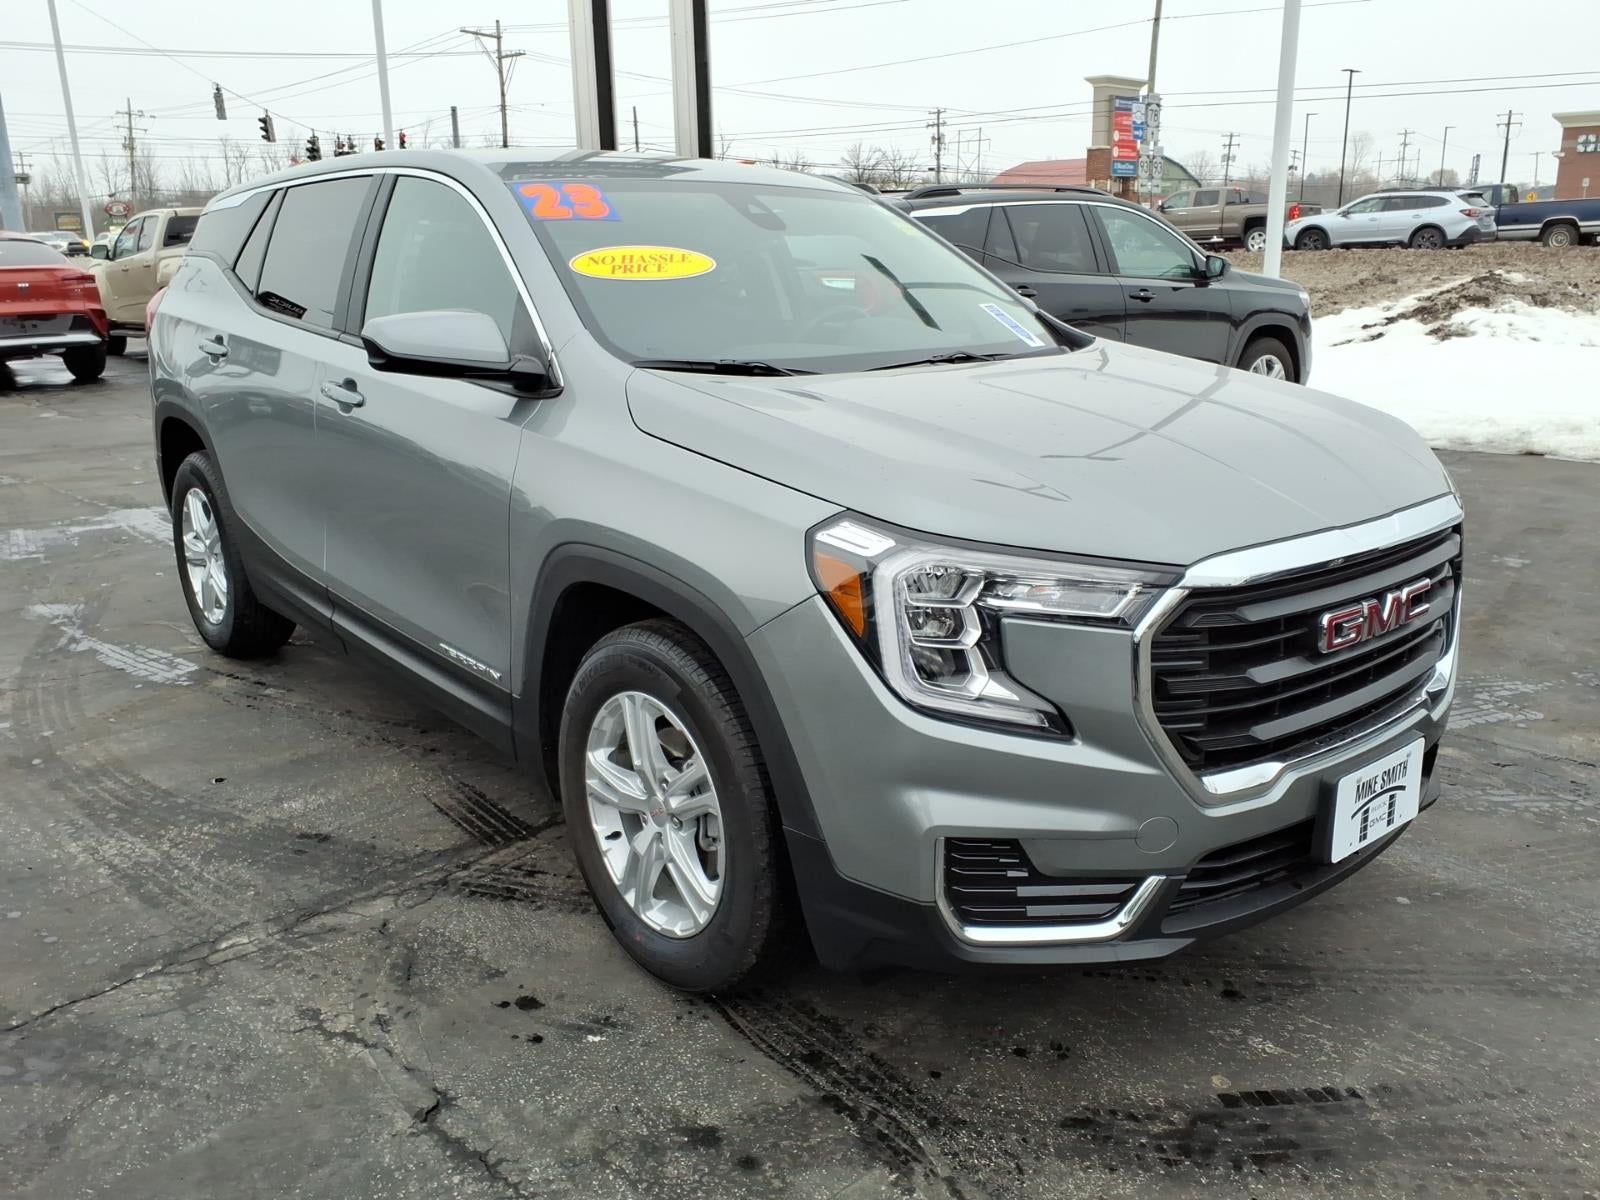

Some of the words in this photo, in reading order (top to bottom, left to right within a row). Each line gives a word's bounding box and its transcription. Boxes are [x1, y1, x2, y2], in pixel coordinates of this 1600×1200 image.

[1140, 160, 1148, 173] 93
[1154, 160, 1163, 174] 93
[518, 183, 610, 220] 23
[587, 255, 616, 267] NO
[621, 253, 692, 265] HASSLE
[611, 263, 669, 275] PRICE
[1318, 578, 1431, 654] GMC
[1355, 775, 1379, 804] MIKE
[1380, 759, 1408, 790] SMITH
